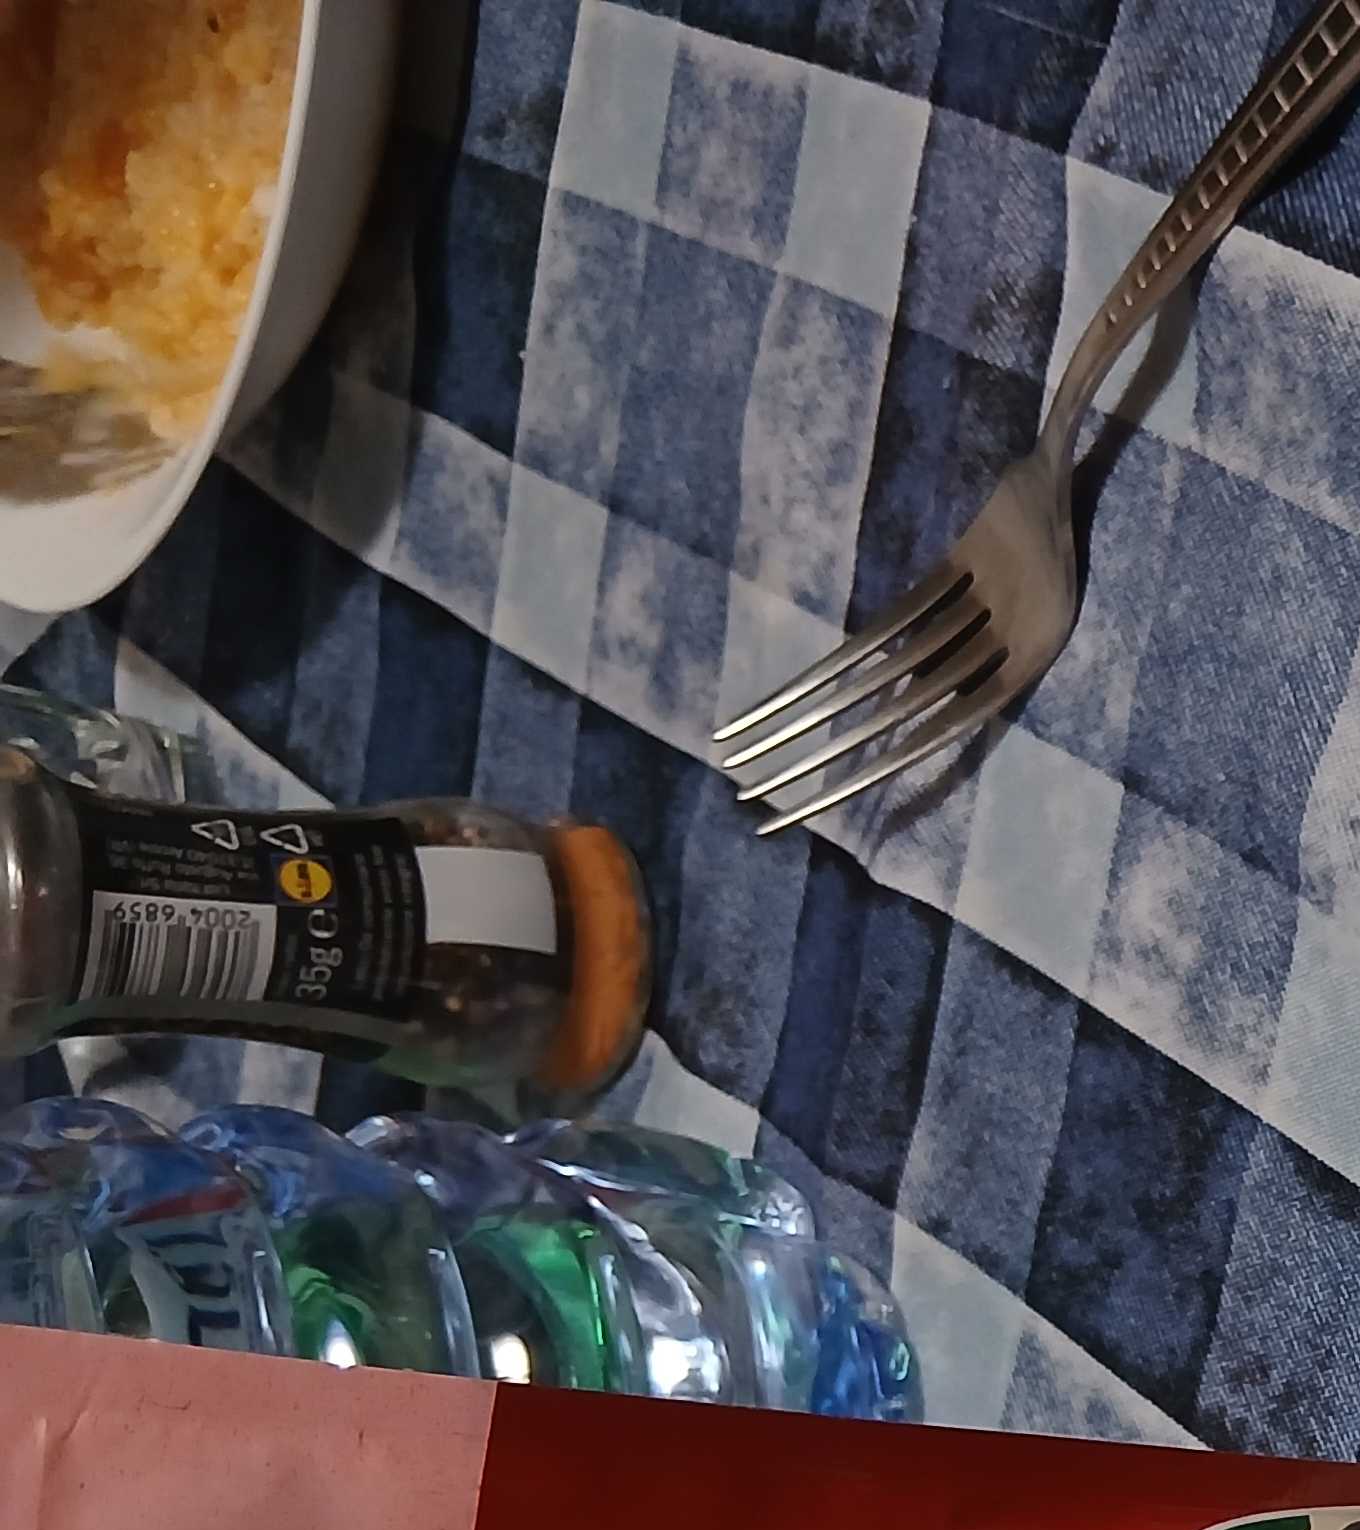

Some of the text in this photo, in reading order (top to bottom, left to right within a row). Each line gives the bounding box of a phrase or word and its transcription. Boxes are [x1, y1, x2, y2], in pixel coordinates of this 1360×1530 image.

[113, 902, 250, 930] 2004 6859
[296, 946, 343, 999] 35g
